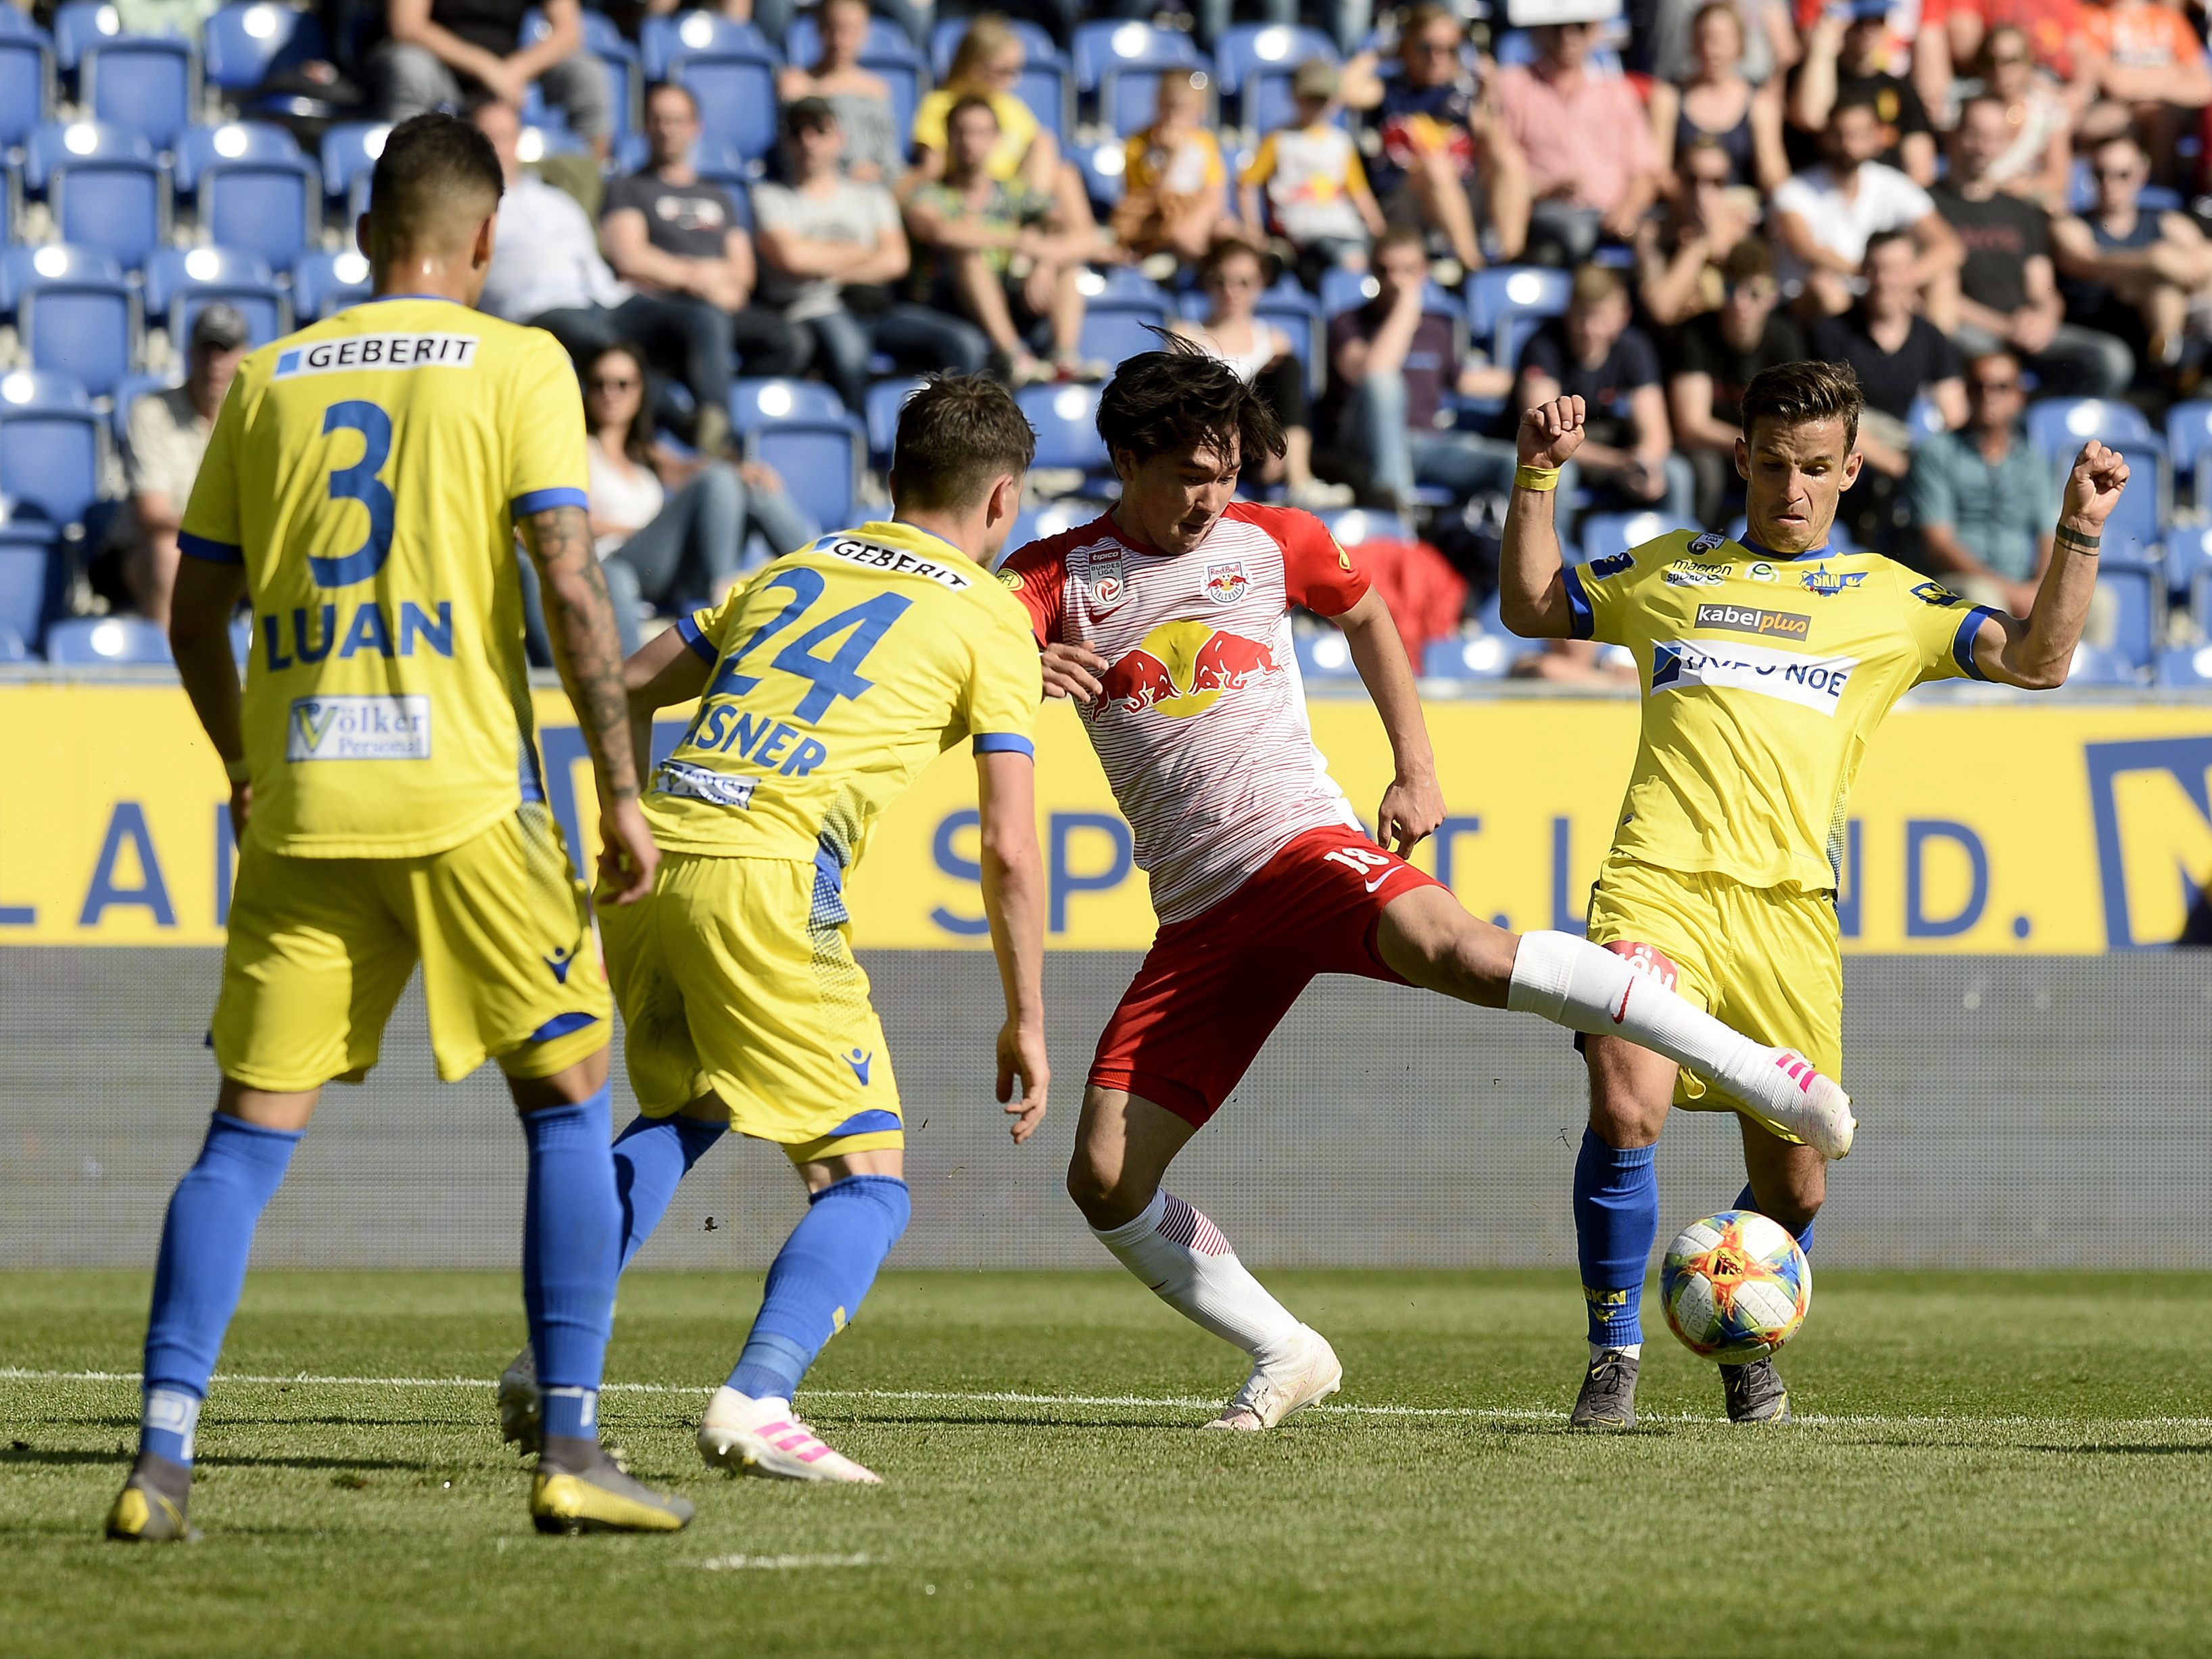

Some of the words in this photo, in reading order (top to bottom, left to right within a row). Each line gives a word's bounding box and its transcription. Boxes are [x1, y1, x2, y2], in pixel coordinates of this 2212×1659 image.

[308, 339, 473, 368] GEBERIT
[308, 400, 395, 587] 3
[833, 540, 968, 586] GEBERIT
[1090, 562, 1120, 571] BUNDES
[1092, 551, 1119, 560] tipico
[1672, 559, 1732, 576] macron
[264, 601, 454, 671] LUAN
[705, 567, 914, 725] 24
[1785, 663, 1847, 698] NOE
[339, 738, 423, 754] Personal
[1323, 847, 1390, 875] 18
[1716, 1250, 1743, 1275] adidas
